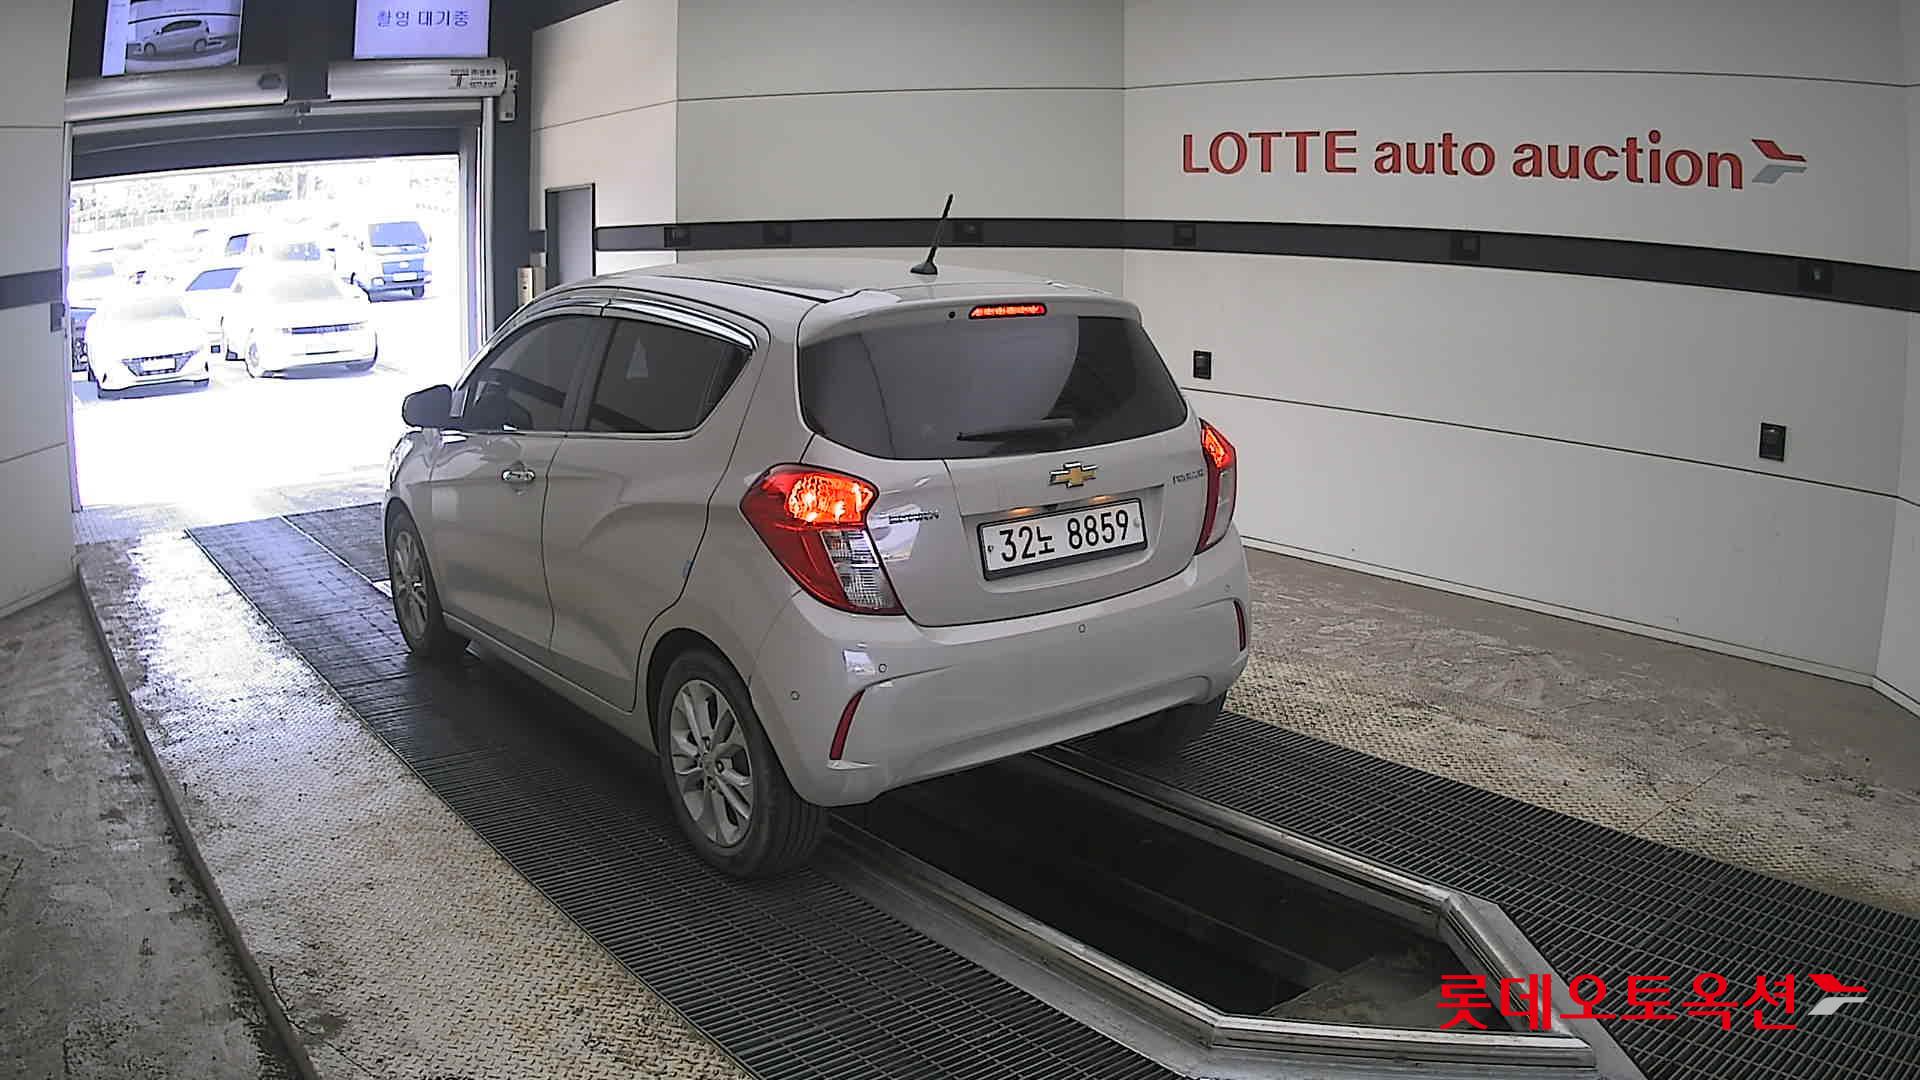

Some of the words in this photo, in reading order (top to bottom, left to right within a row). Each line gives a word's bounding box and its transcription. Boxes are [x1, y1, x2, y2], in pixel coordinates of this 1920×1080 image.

[418, 9, 469, 28] 대기중
[1182, 130, 1358, 175] LOTTE
[1374, 132, 1496, 176] auto
[1512, 129, 1744, 190] auction
[1000, 525, 1056, 563] 32노
[1066, 509, 1130, 550] 8859
